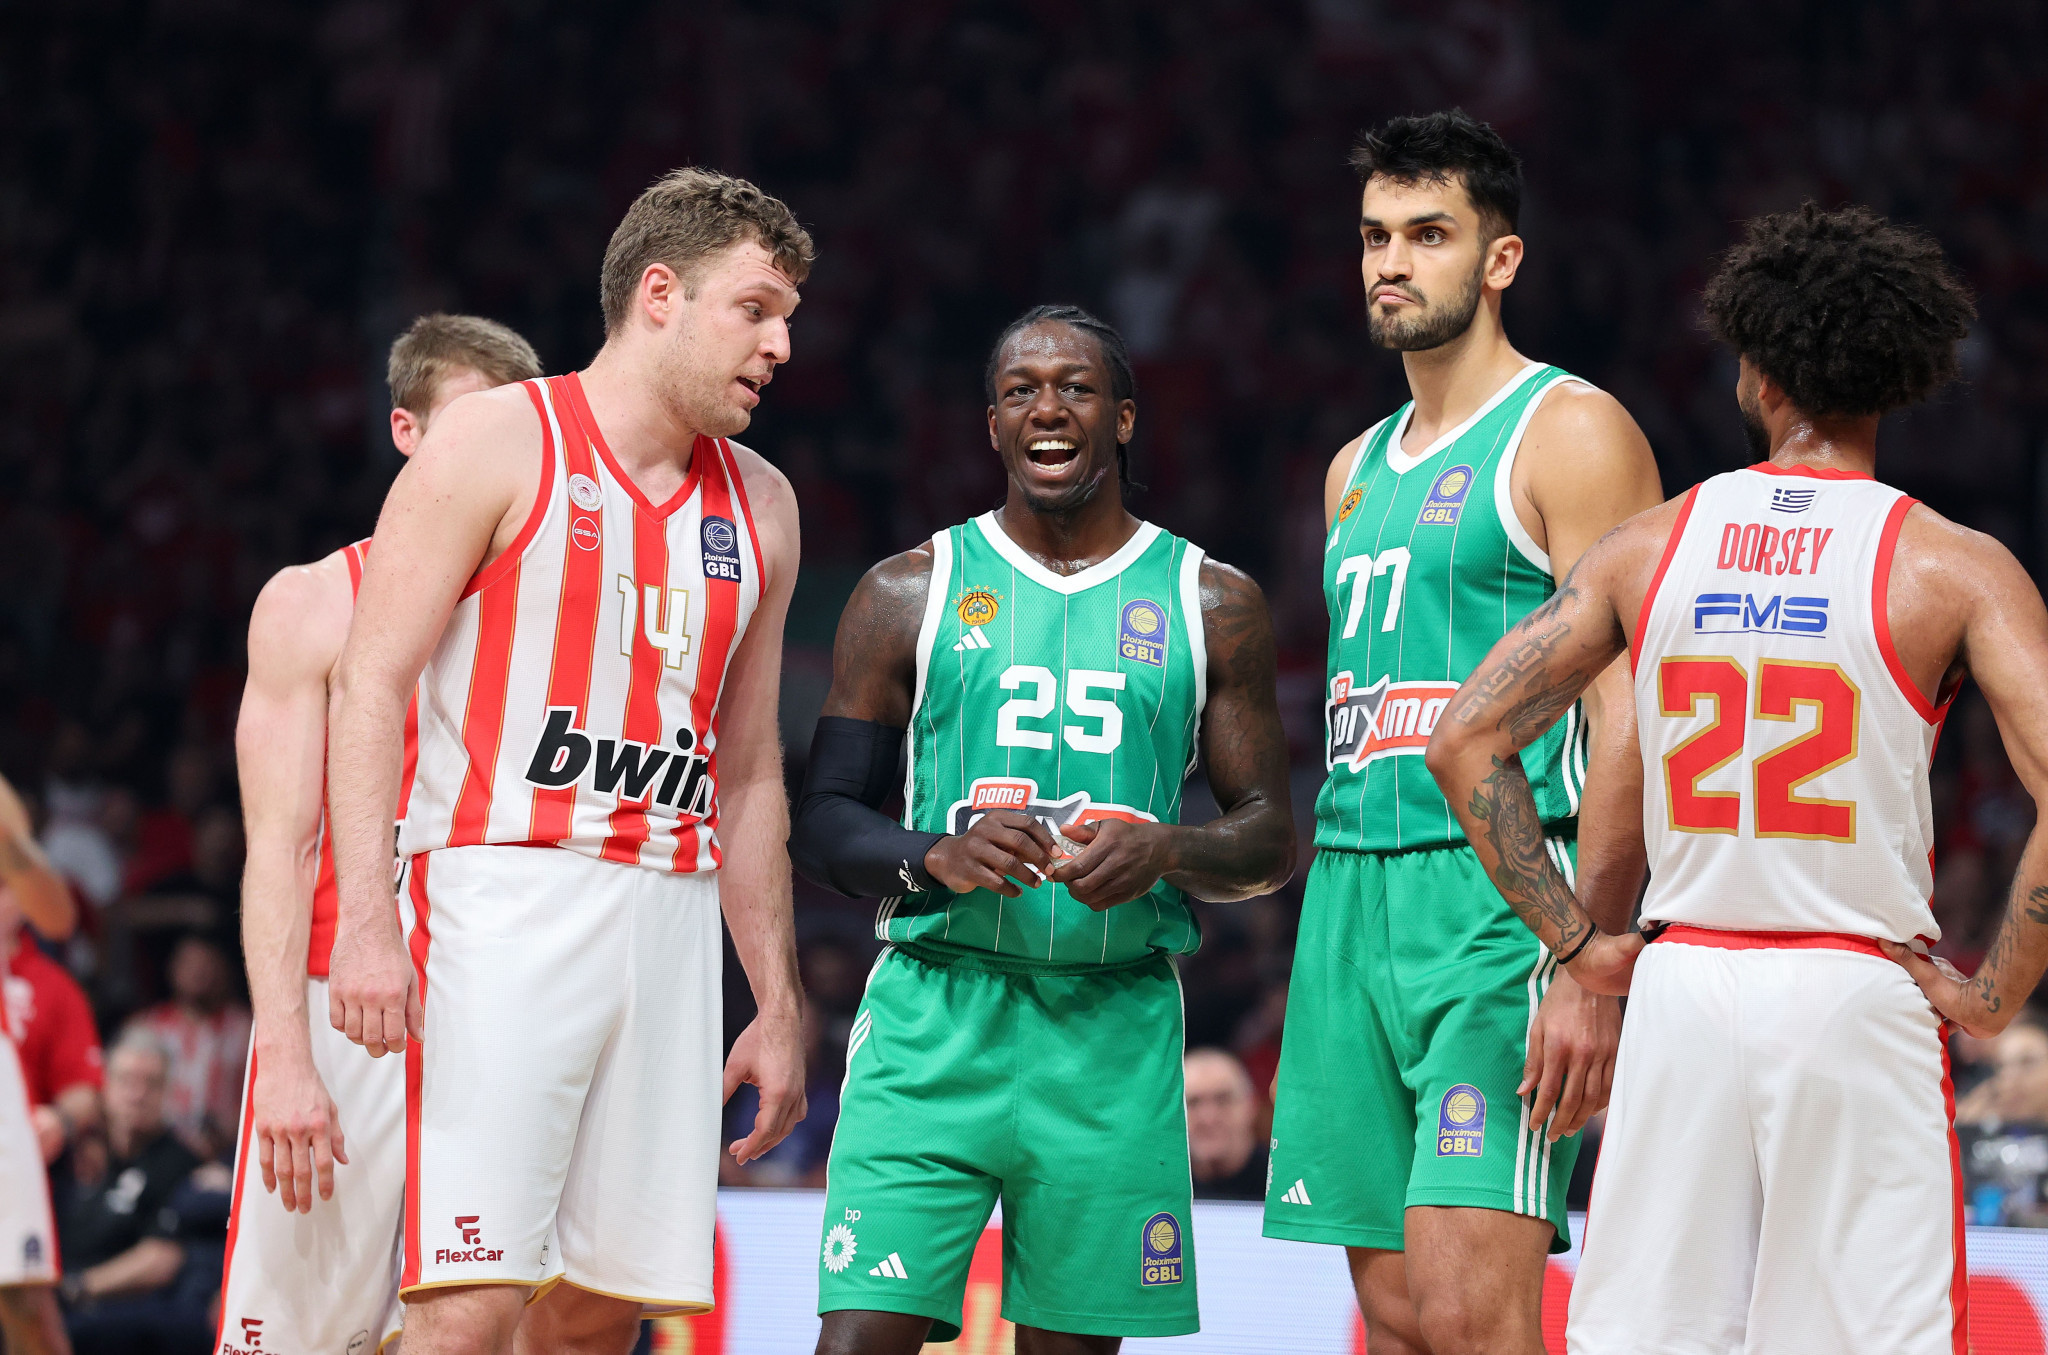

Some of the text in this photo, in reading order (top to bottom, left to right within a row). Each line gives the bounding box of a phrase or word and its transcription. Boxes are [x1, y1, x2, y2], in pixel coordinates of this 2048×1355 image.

[1423, 508, 1454, 522] GBL
[575, 528, 598, 539] GSA
[703, 552, 739, 564] Stoiximan
[1716, 523, 1834, 576] DORSEY
[705, 561, 739, 579] GBL
[1336, 546, 1411, 639] 77
[617, 573, 691, 670] 14
[1694, 593, 1829, 635] FMS
[1121, 633, 1163, 650] Stoiximan
[1122, 643, 1160, 664] GBL
[996, 664, 1126, 754] 25
[1657, 655, 1861, 844] 22
[523, 706, 709, 816] bwin
[976, 786, 1025, 809] pame
[1439, 1127, 1482, 1137] Stoiximan
[1440, 1137, 1479, 1153] GBL
[845, 1206, 861, 1224] bp
[435, 1247, 504, 1264] FlexCar
[1144, 1257, 1181, 1266] Stoiximan
[1145, 1265, 1180, 1282] GBL
